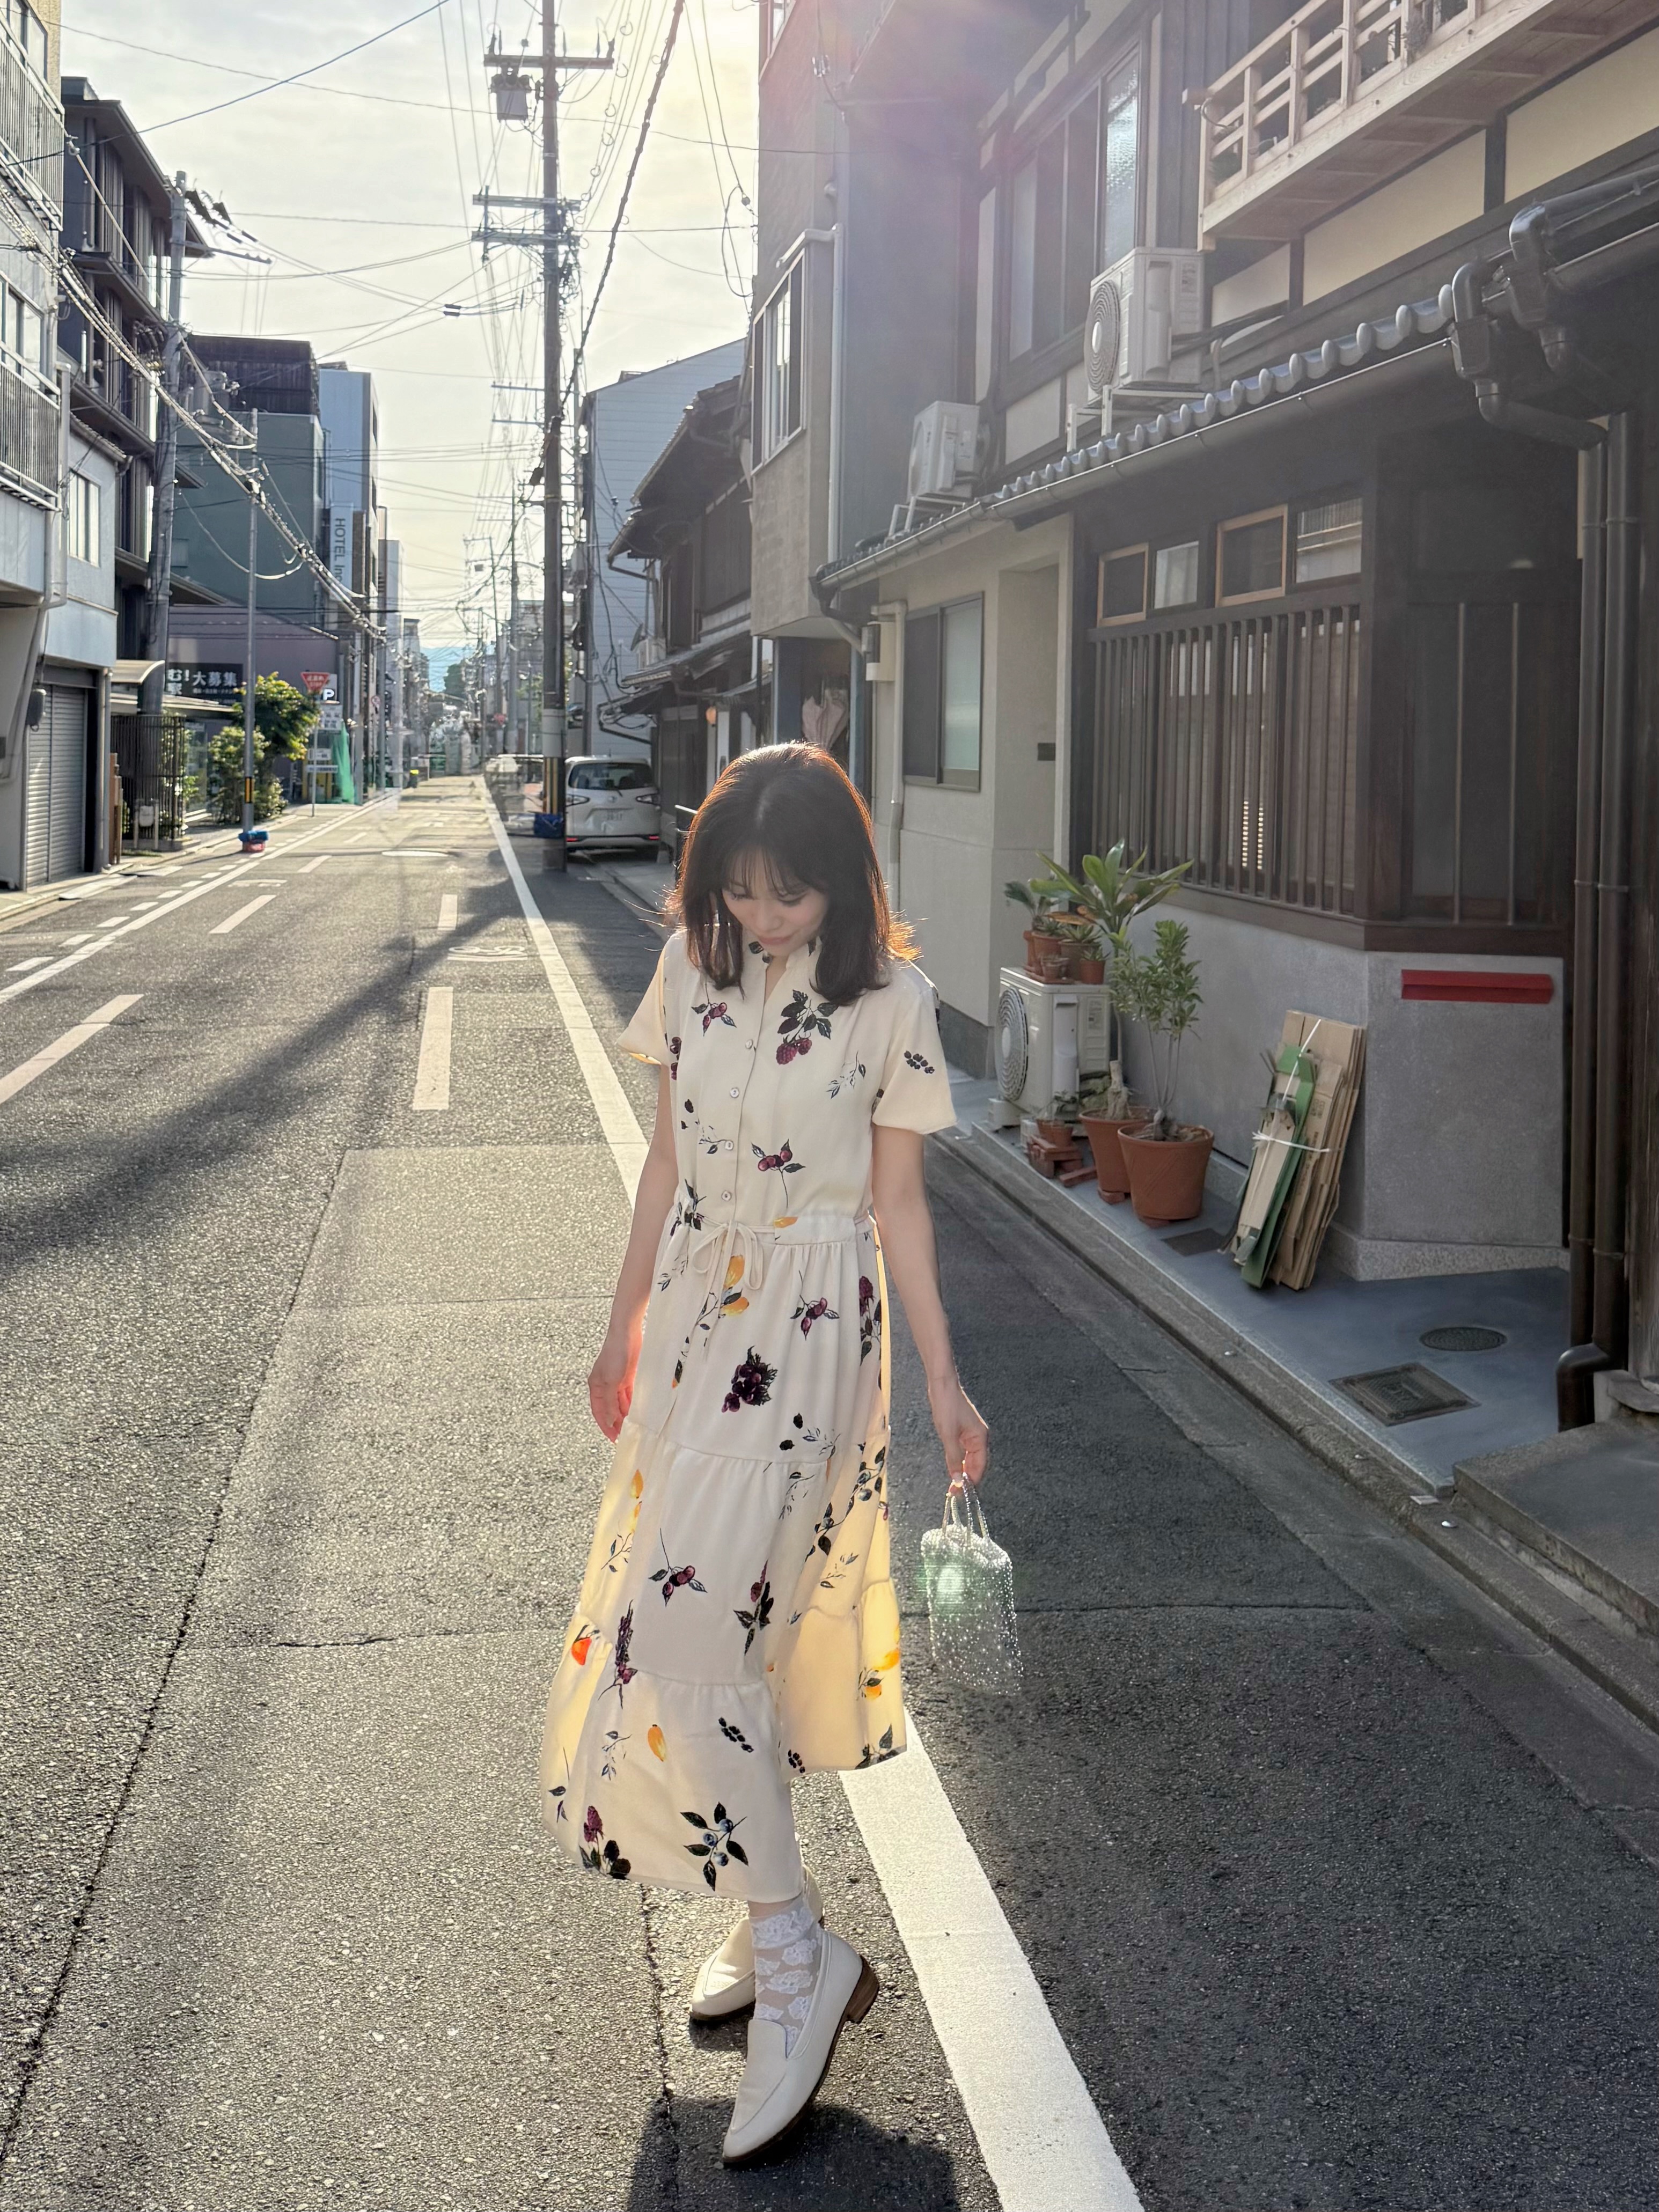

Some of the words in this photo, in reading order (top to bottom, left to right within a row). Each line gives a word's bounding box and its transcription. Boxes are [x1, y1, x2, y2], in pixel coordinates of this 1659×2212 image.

[334, 518, 346, 561] HOTEL
[193, 671, 237, 686] 大募集
[323, 689, 335, 700] P
